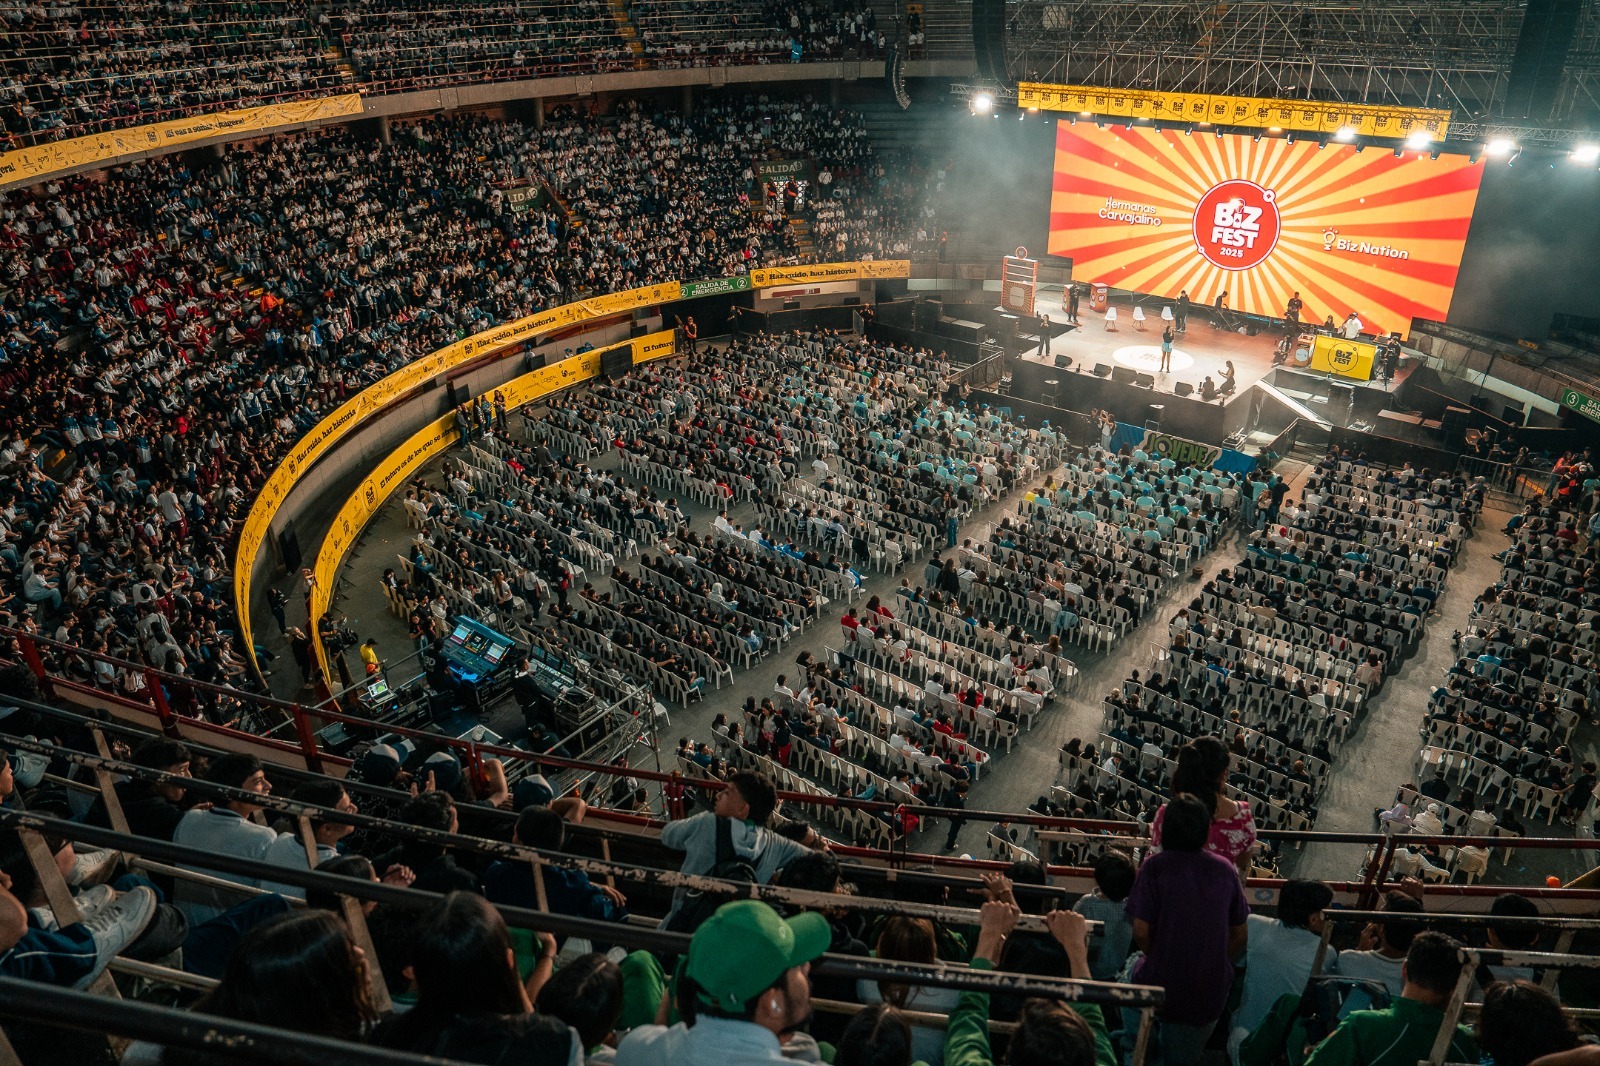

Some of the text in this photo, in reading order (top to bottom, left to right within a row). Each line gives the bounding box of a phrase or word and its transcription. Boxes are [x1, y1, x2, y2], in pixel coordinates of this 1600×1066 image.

[760, 164, 796, 173] SALIDA
[1106, 196, 1156, 214] Hermanas
[1098, 208, 1162, 226] Carvajalino
[1211, 226, 1258, 248] FEST
[1220, 247, 1244, 258] 2025
[692, 285, 734, 296] EMERGENCIA
[696, 282, 719, 290] SALIDA
[477, 316, 556, 348] Haz ruido, haz historia
[651, 341, 674, 350] futuro
[332, 409, 356, 430] historia
[385, 465, 400, 483] futuro
[407, 454, 414, 463] de
[414, 448, 422, 458] los
